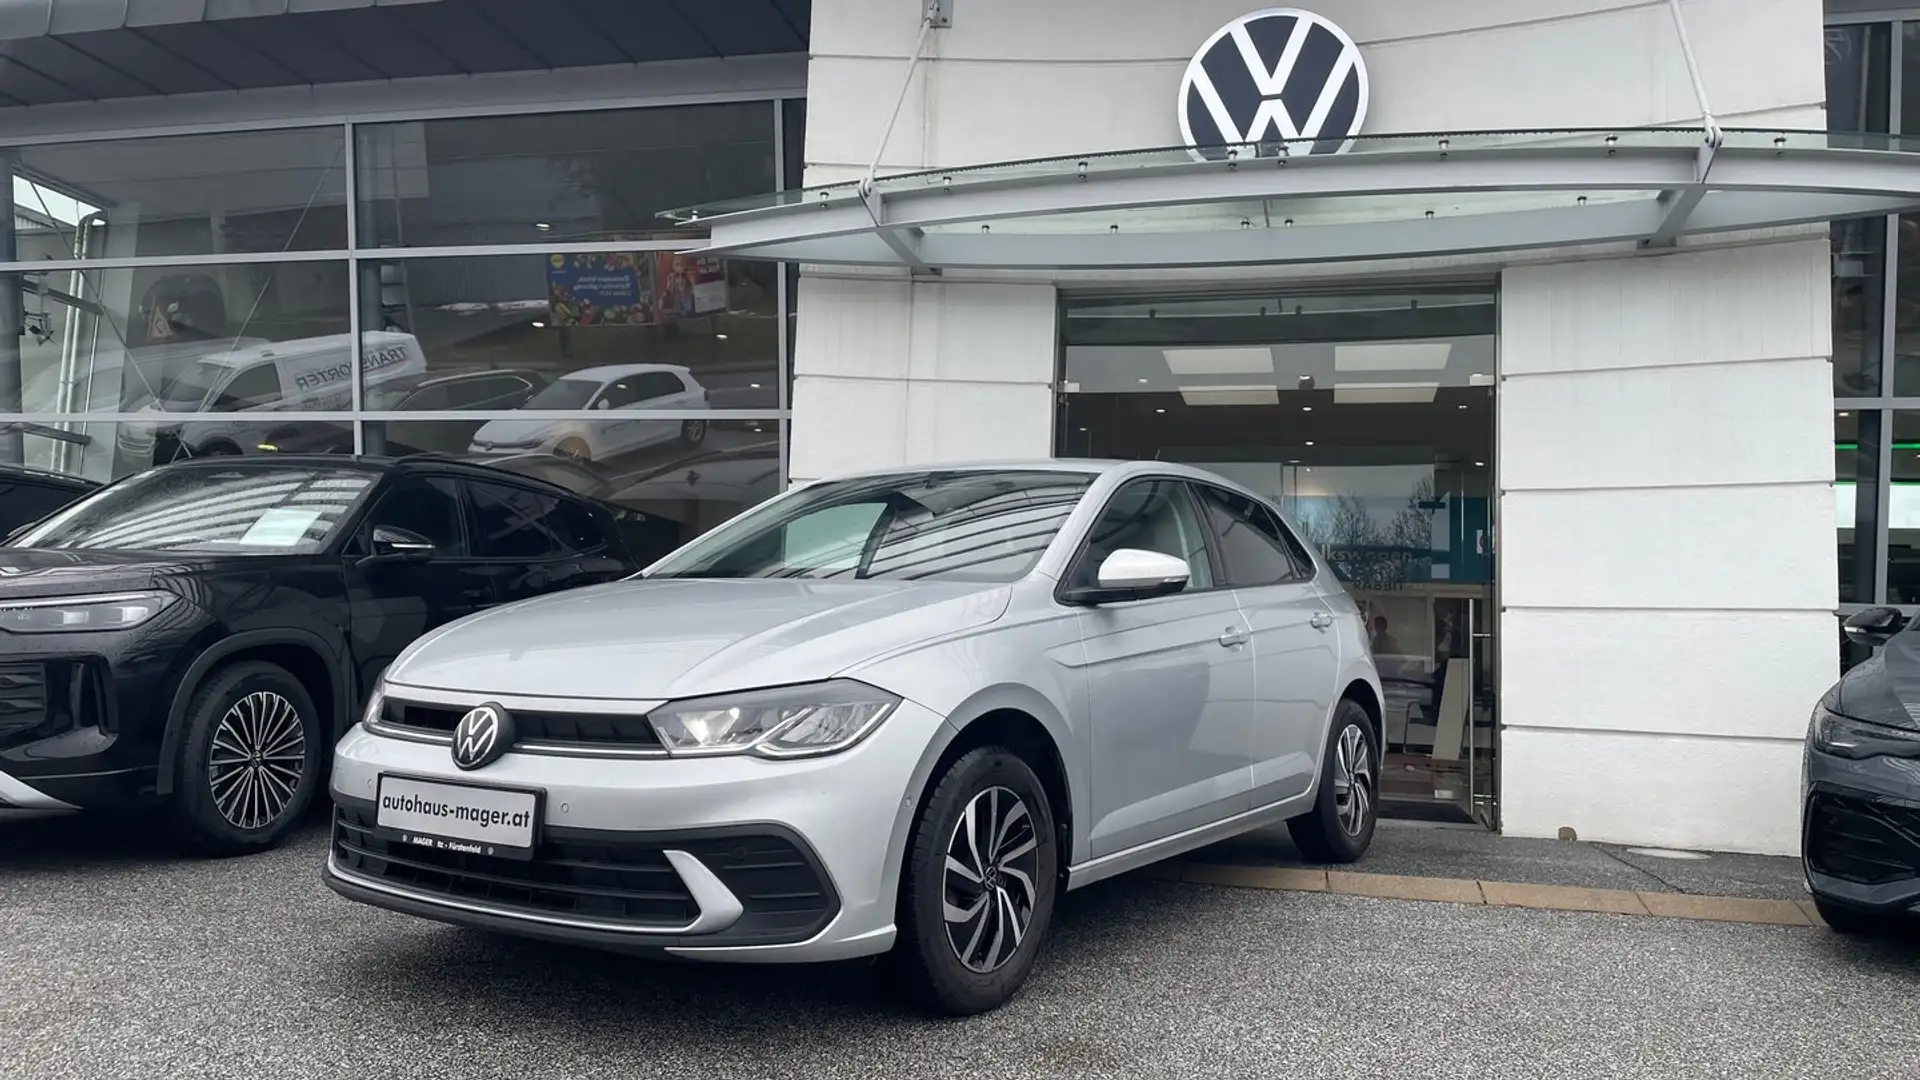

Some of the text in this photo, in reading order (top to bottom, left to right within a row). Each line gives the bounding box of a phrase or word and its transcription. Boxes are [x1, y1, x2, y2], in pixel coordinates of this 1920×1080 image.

[1321, 543, 1414, 566] lkswagen
[382, 794, 530, 828] autohaus-mager.at
[412, 836, 434, 847] MAGER
